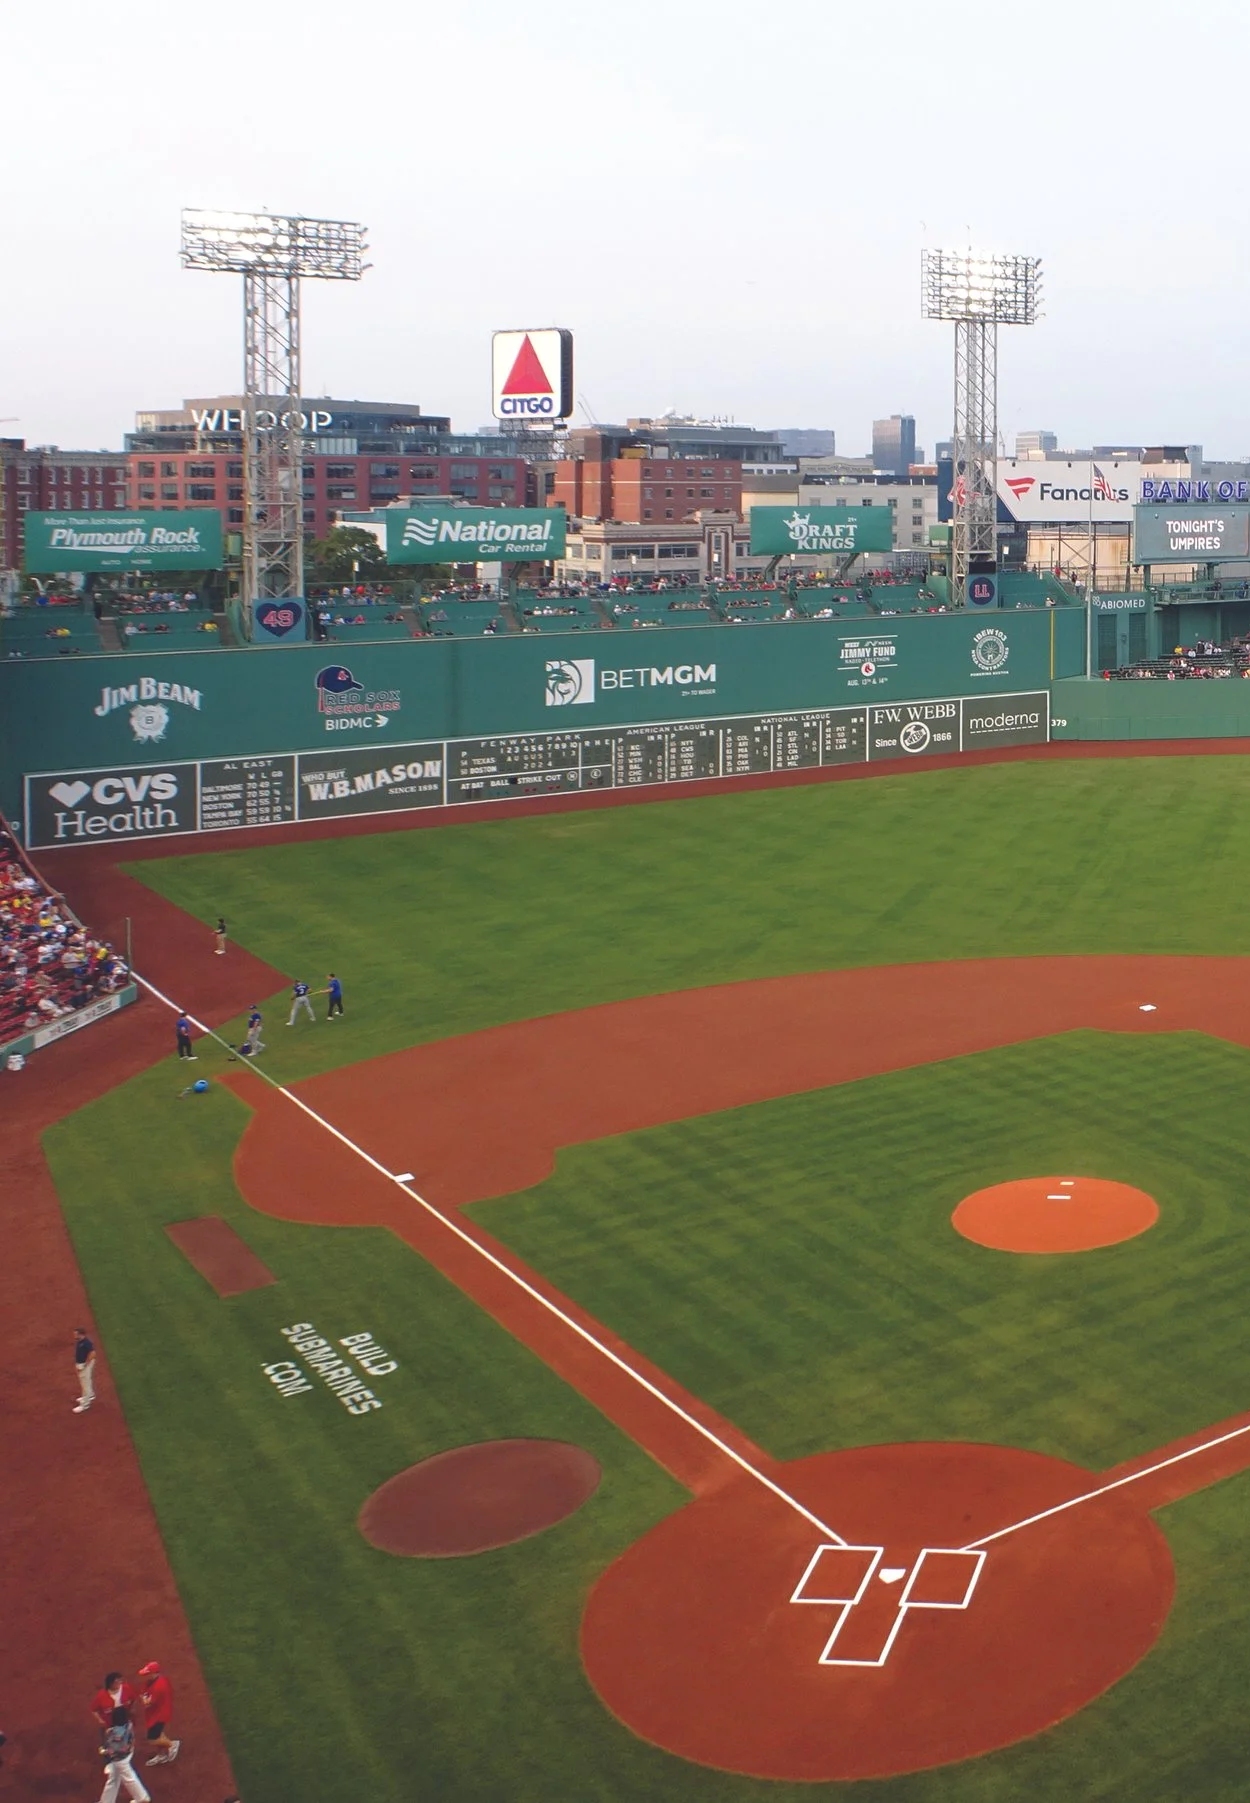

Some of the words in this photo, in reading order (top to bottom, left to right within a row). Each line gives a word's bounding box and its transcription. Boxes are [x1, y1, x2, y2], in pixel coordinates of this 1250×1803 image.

[500, 397, 553, 414] CITGO
[191, 409, 333, 433] WHOOP
[1142, 480, 1210, 499] BANK
[1218, 480, 1247, 499] OF
[438, 519, 552, 543] National
[789, 524, 857, 540] DRAFT
[1166, 519, 1225, 533] TONIGHT'S
[50, 527, 147, 548] Plymouth
[150, 527, 200, 545] Rock
[797, 538, 855, 550] KINGS
[1170, 537, 1221, 550] UMPIRES
[134, 544, 201, 553] assurance
[479, 543, 500, 553] Car
[505, 542, 547, 553] Rental
[1100, 599, 1146, 609] ABIOMED
[840, 648, 871, 659] JIMMY
[873, 646, 896, 657] FUND
[601, 664, 716, 690] BETMGM
[95, 684, 138, 716] JIM
[140, 677, 202, 711] BEAM
[325, 693, 360, 705] RED
[365, 690, 401, 703] SOX
[324, 702, 401, 715] SCHOLARS
[907, 704, 956, 721] WEBB
[325, 717, 373, 730] BIDMC
[761, 716, 798, 724] NATIONAL
[801, 713, 830, 721] LEAGUE
[969, 713, 1040, 729] moderna
[1051, 719, 1067, 727] 379
[626, 726, 670, 736] AMERICAN
[673, 724, 706, 732] LEAGUE
[481, 737, 536, 748] FENWAY
[546, 734, 581, 742] PARK
[875, 737, 897, 748] Since
[933, 733, 952, 742] 1866
[242, 760, 273, 769] EAST
[471, 757, 496, 765] TEXAS
[302, 773, 325, 783] WHO
[326, 770, 345, 780] BUT
[470, 766, 497, 775] BOSTON
[92, 773, 178, 805] CVS
[471, 782, 484, 790] BAT
[490, 779, 510, 787] BALL
[516, 776, 543, 785] STRIKE
[545, 774, 562, 782] OUT
[388, 786, 416, 795] SINCE
[202, 794, 219, 802] NEW
[202, 802, 235, 811] BOSTON
[53, 803, 179, 838] Health
[202, 819, 240, 828] TORONTO
[338, 1332, 398, 1376] BUILD
[280, 1322, 383, 1415] SUBMARINES
[260, 1361, 314, 1397] .COM
